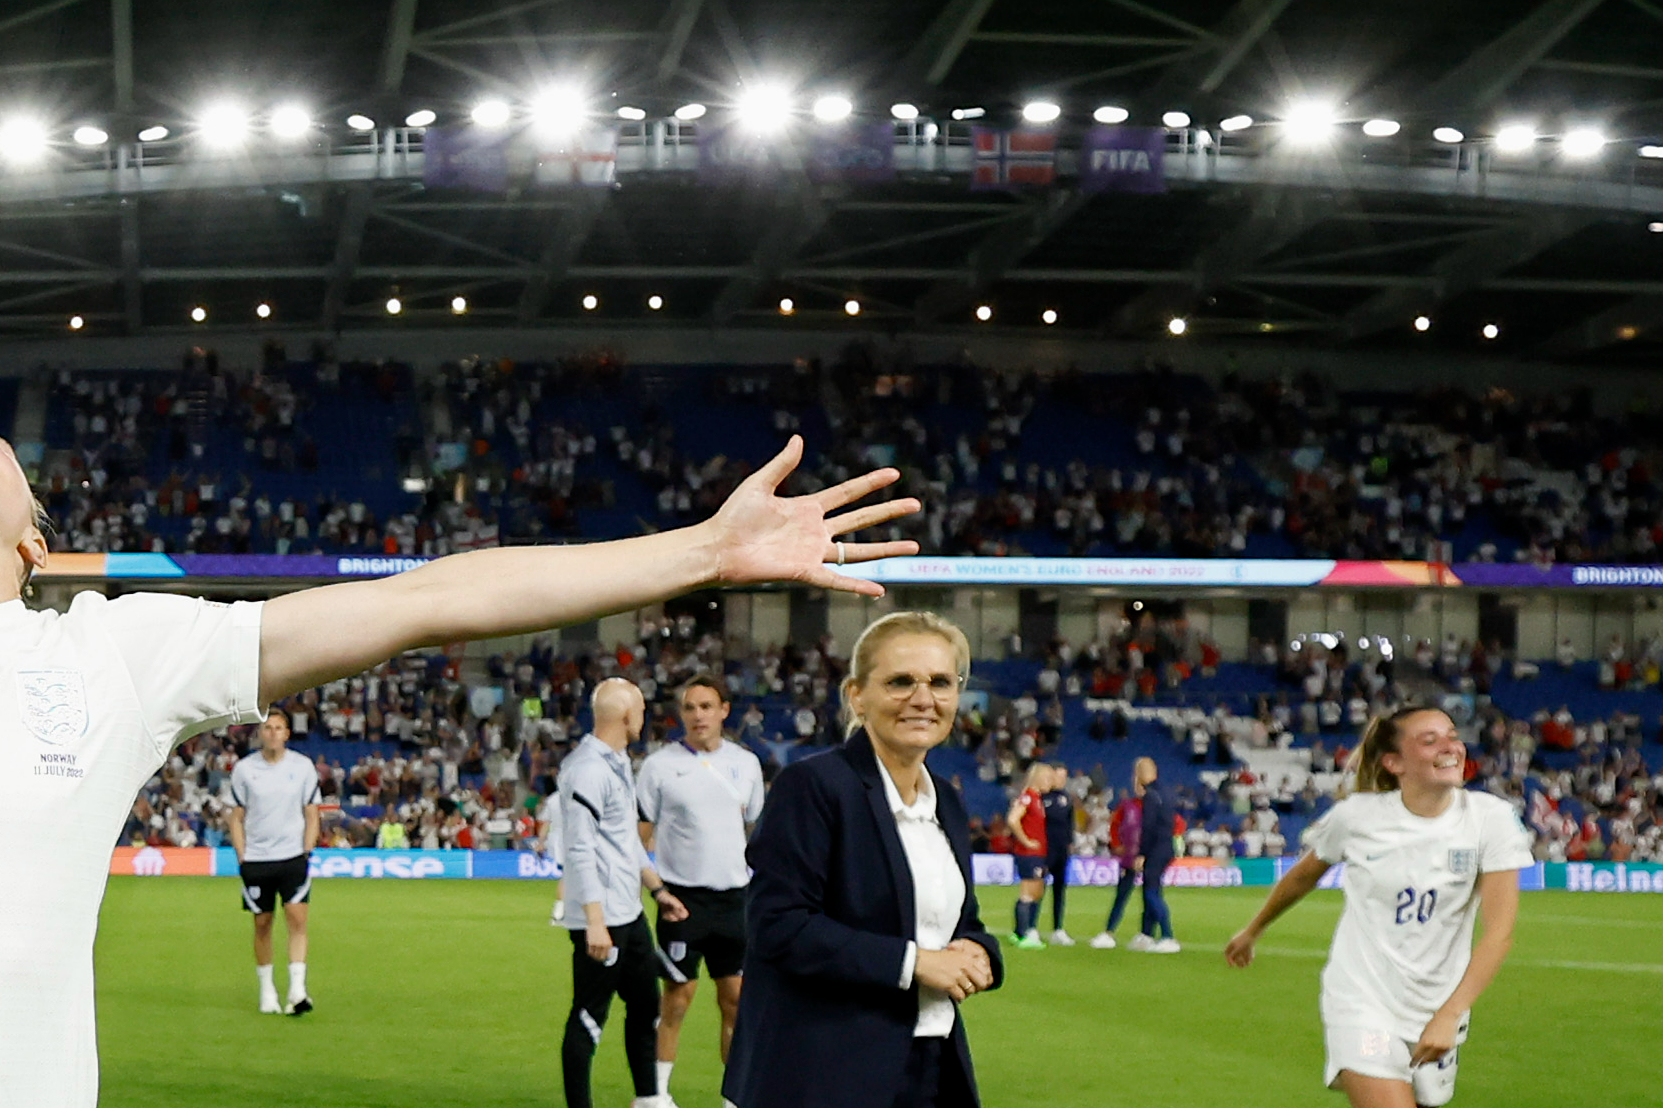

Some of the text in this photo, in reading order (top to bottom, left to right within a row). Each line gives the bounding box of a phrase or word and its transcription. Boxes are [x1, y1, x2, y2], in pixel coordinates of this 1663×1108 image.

[1092, 150, 1150, 170] FIFA
[40, 754, 77, 765] NORWAY
[34, 766, 84, 778] 11 JULY 2022
[307, 856, 444, 878] ense
[1395, 886, 1437, 925] 20
